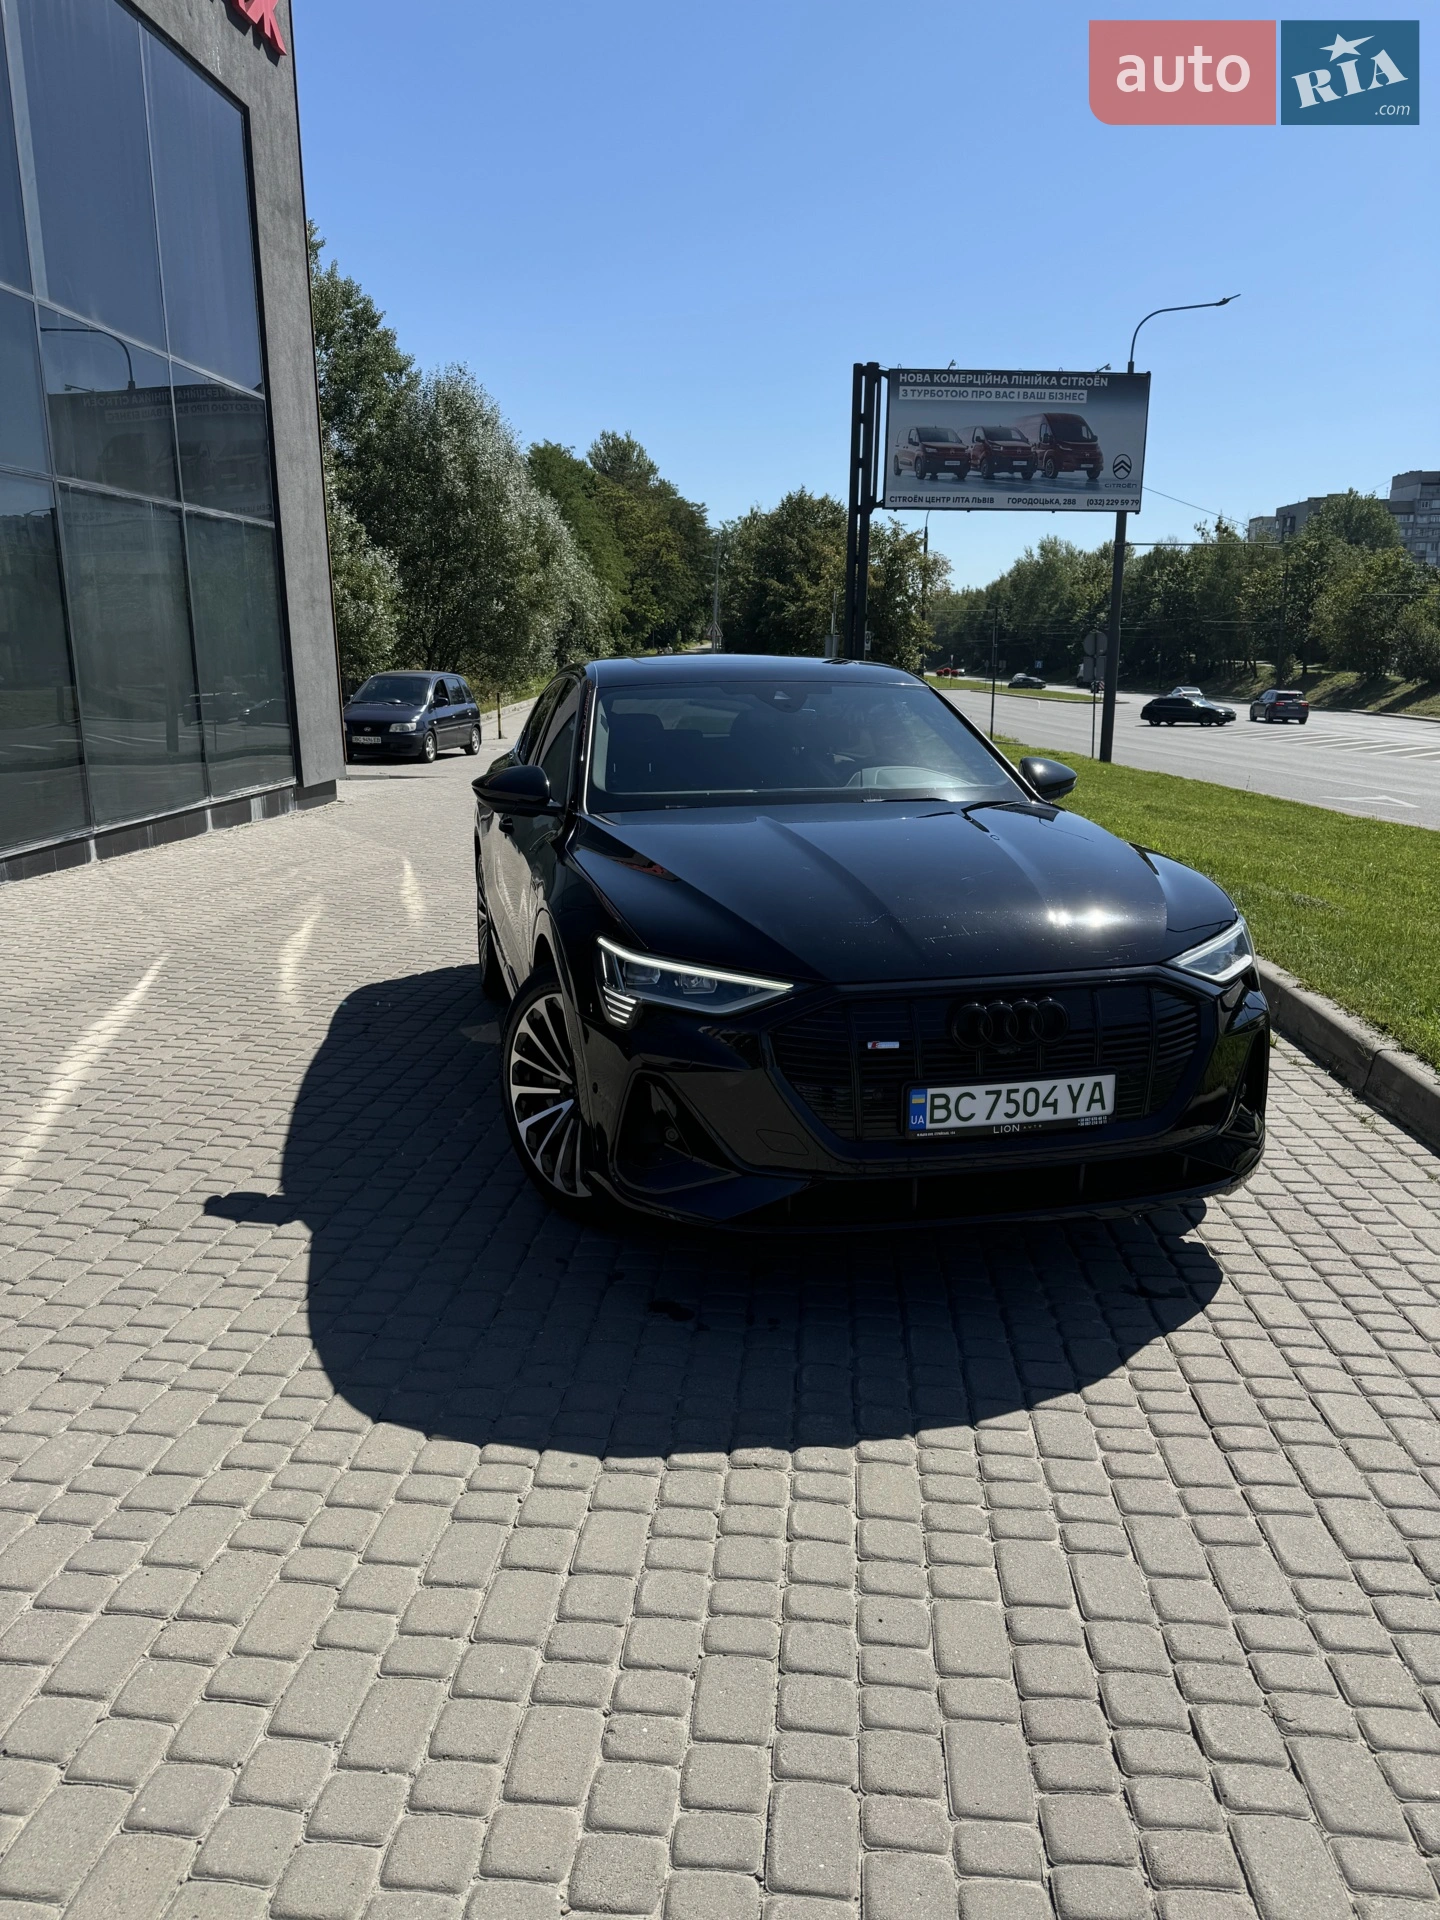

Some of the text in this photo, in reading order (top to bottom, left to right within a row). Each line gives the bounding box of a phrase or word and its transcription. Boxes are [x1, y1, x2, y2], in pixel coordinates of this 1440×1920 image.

[900, 372, 1109, 387] НОВА КОМЕРЦІЙНА ЛІНІЙКА CITROËN
[910, 389, 969, 399] ТУРБОТОЮ
[971, 390, 993, 399] ПРО
[995, 391, 1016, 400] ВАС
[1023, 391, 1046, 401] ВАШ
[1048, 392, 1085, 401] БІЗНЕС
[889, 495, 925, 504] CITROËN
[925, 496, 951, 504] ЦЕНТР
[952, 496, 970, 504] ІЛТА
[1063, 498, 1077, 506] 288
[1086, 499, 1105, 507] (032)
[910, 1115, 925, 1125] UA
[993, 1124, 1020, 1134] LION
